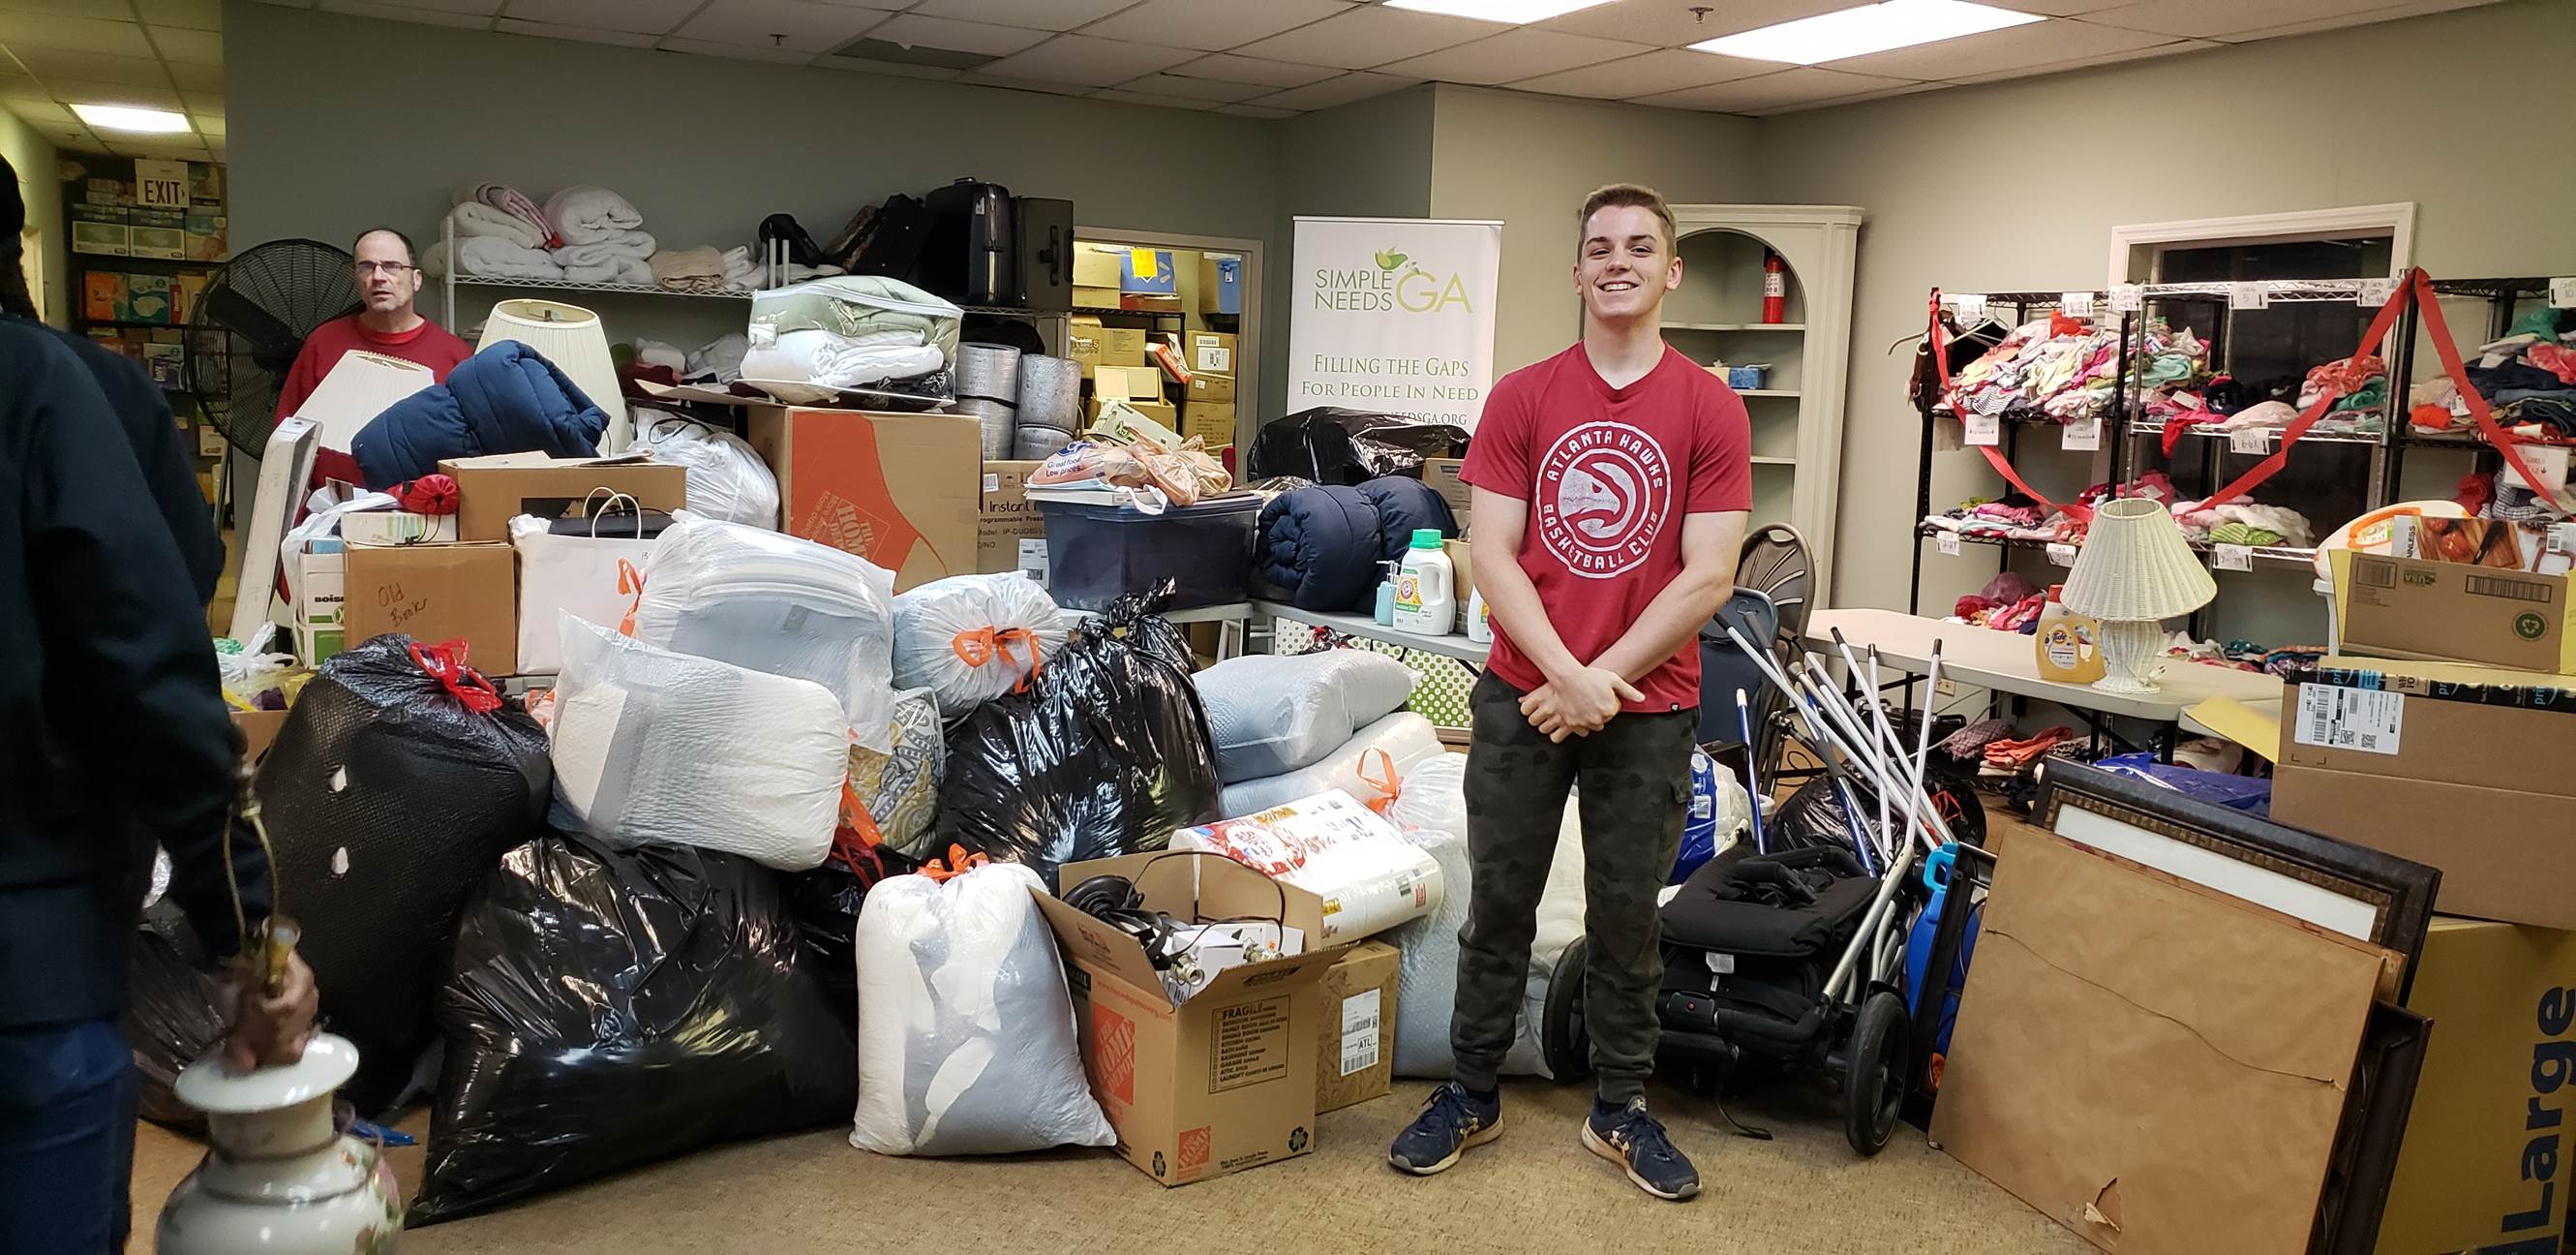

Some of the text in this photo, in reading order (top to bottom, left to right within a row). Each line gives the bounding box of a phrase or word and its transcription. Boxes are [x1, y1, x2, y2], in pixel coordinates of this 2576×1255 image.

[145, 180, 181, 204] EXIT
[1315, 269, 1393, 290] SIMPLE
[1315, 291, 1393, 311] NEEDS
[1395, 270, 1473, 313] GA
[1386, 358, 1420, 375] THE
[1547, 430, 1663, 489] ATLANTA HAWKS
[1046, 469, 1059, 477] Low
[989, 500, 1030, 513] Instant
[980, 516, 1023, 524] rogrammable
[1544, 504, 1658, 569] BASKETBALL CLUB
[2407, 525, 2416, 558] AINLESS
[378, 582, 405, 607] Old
[1223, 1003, 1263, 1019] FRAGILE
[1358, 1038, 1371, 1049] ATL
[2501, 986, 2576, 1234] Large
